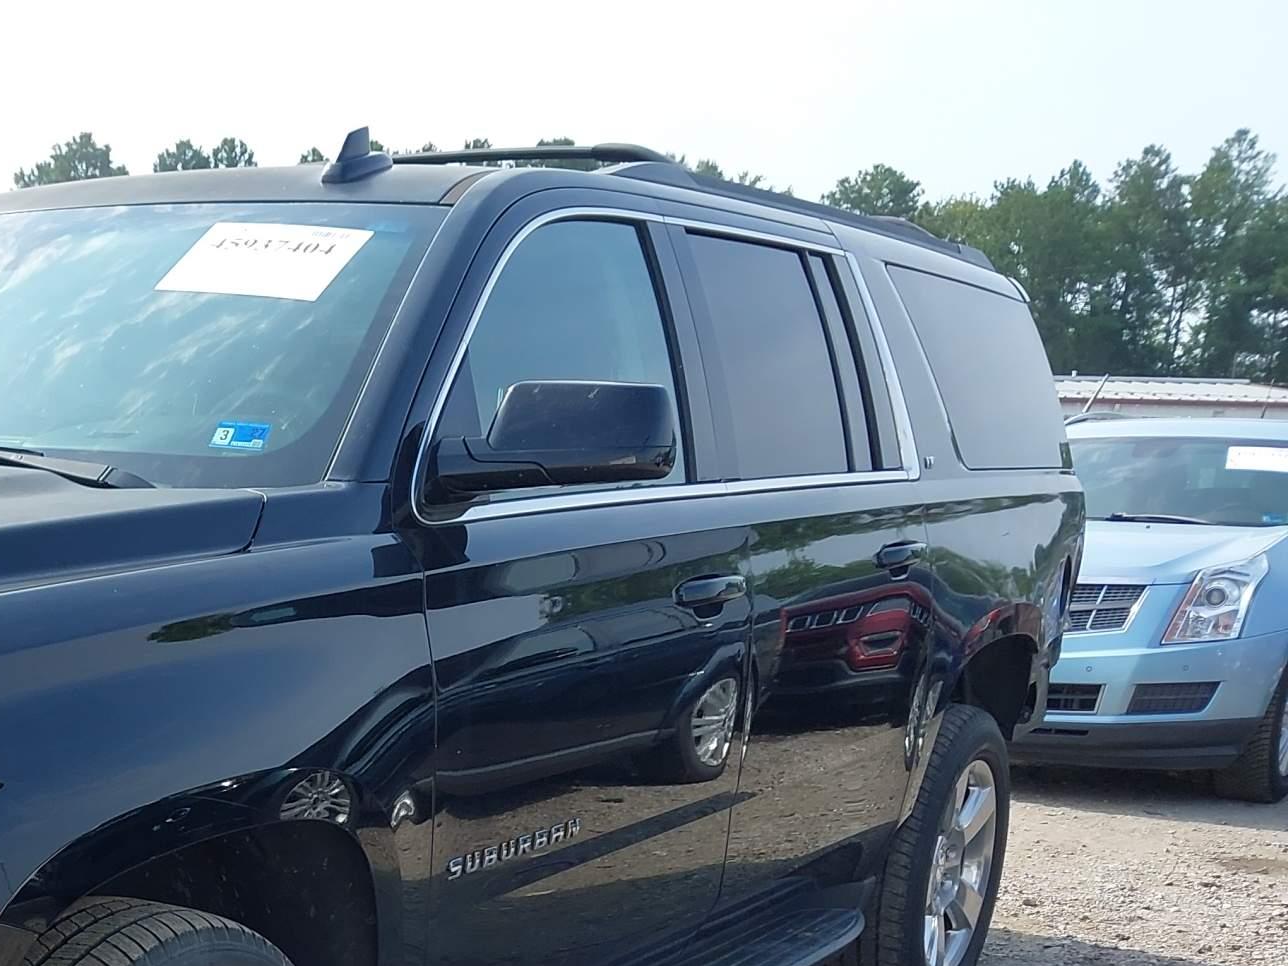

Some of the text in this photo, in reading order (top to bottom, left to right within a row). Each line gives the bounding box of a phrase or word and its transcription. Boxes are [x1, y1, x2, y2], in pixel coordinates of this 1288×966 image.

[210, 238, 337, 256] 45937404
[219, 429, 230, 441] 3
[447, 817, 581, 881] SUBURBAN
